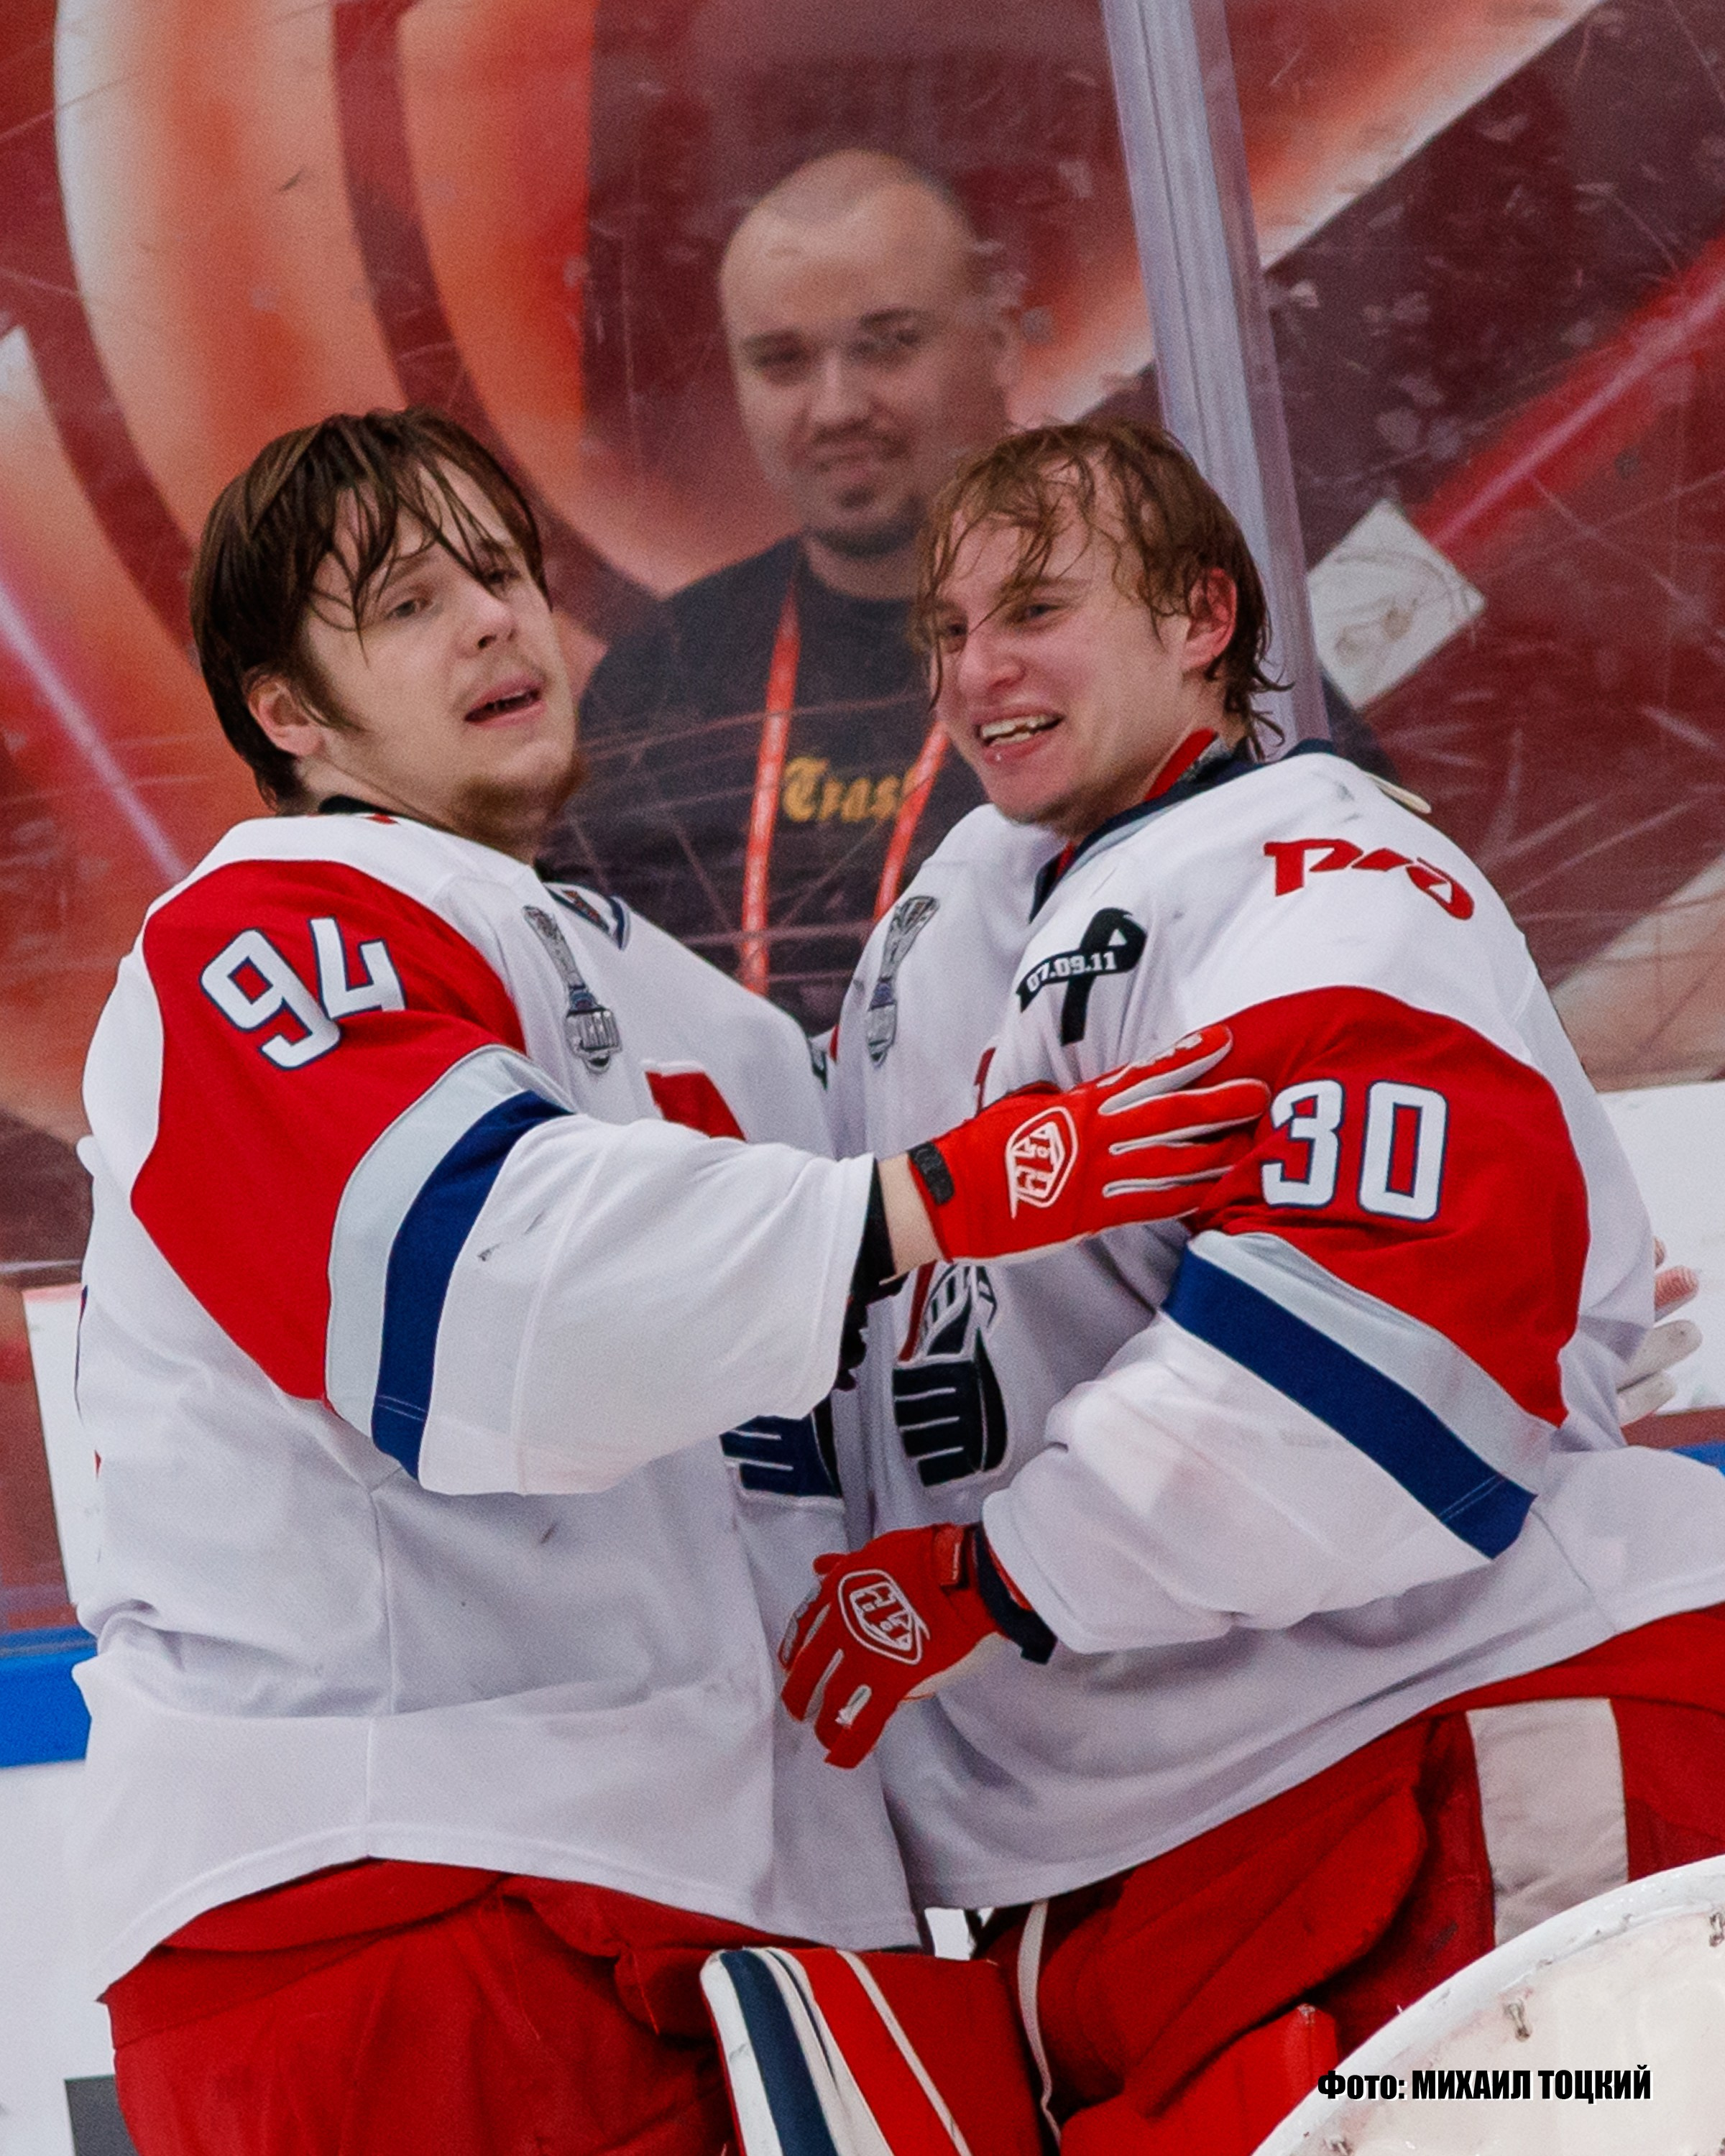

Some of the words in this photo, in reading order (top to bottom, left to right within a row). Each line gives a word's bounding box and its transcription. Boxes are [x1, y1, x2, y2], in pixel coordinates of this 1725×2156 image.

[199, 915, 407, 1071] 94
[1026, 951, 1118, 992] 07.09.11
[1261, 1079, 1449, 1223] 30
